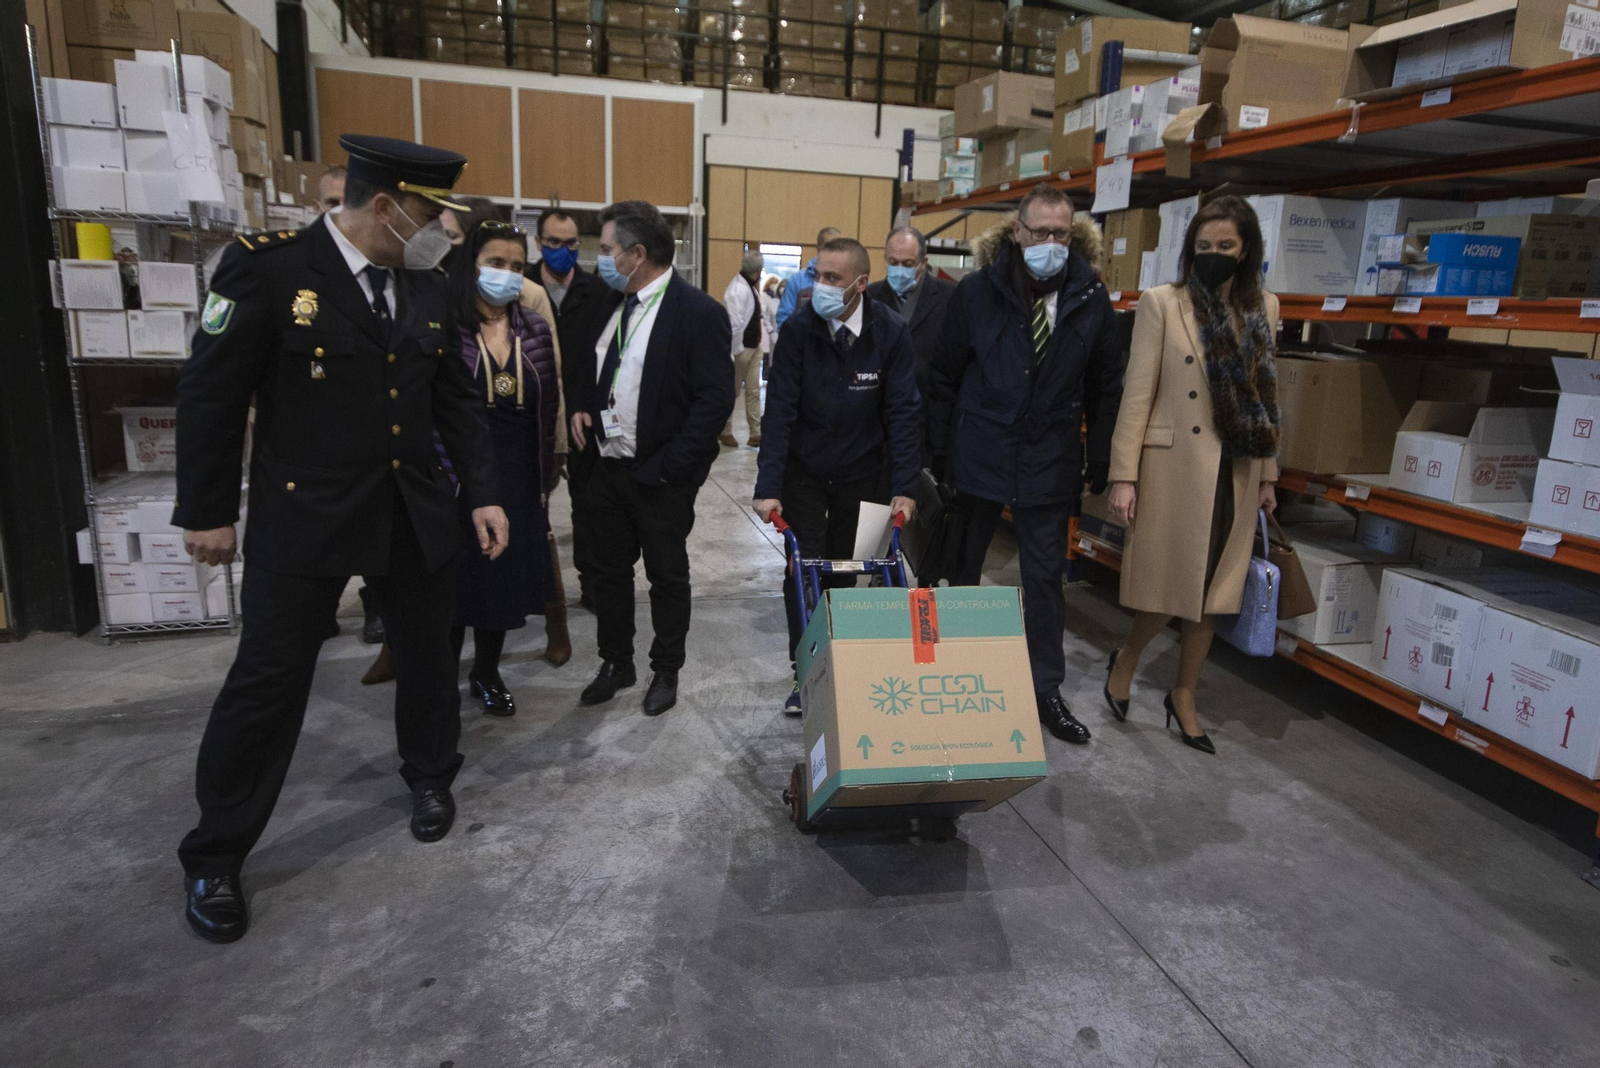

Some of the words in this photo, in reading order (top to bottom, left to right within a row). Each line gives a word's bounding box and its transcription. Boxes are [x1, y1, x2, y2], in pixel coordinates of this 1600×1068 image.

[1289, 213, 1321, 228] Bexen
[1322, 216, 1357, 230] medical
[857, 373, 878, 381] TIPSA
[839, 601, 873, 610] FARMA
[946, 599, 1011, 609] CONTROLADA
[918, 674, 1004, 696] COOL
[920, 696, 1007, 715] CHAIN
